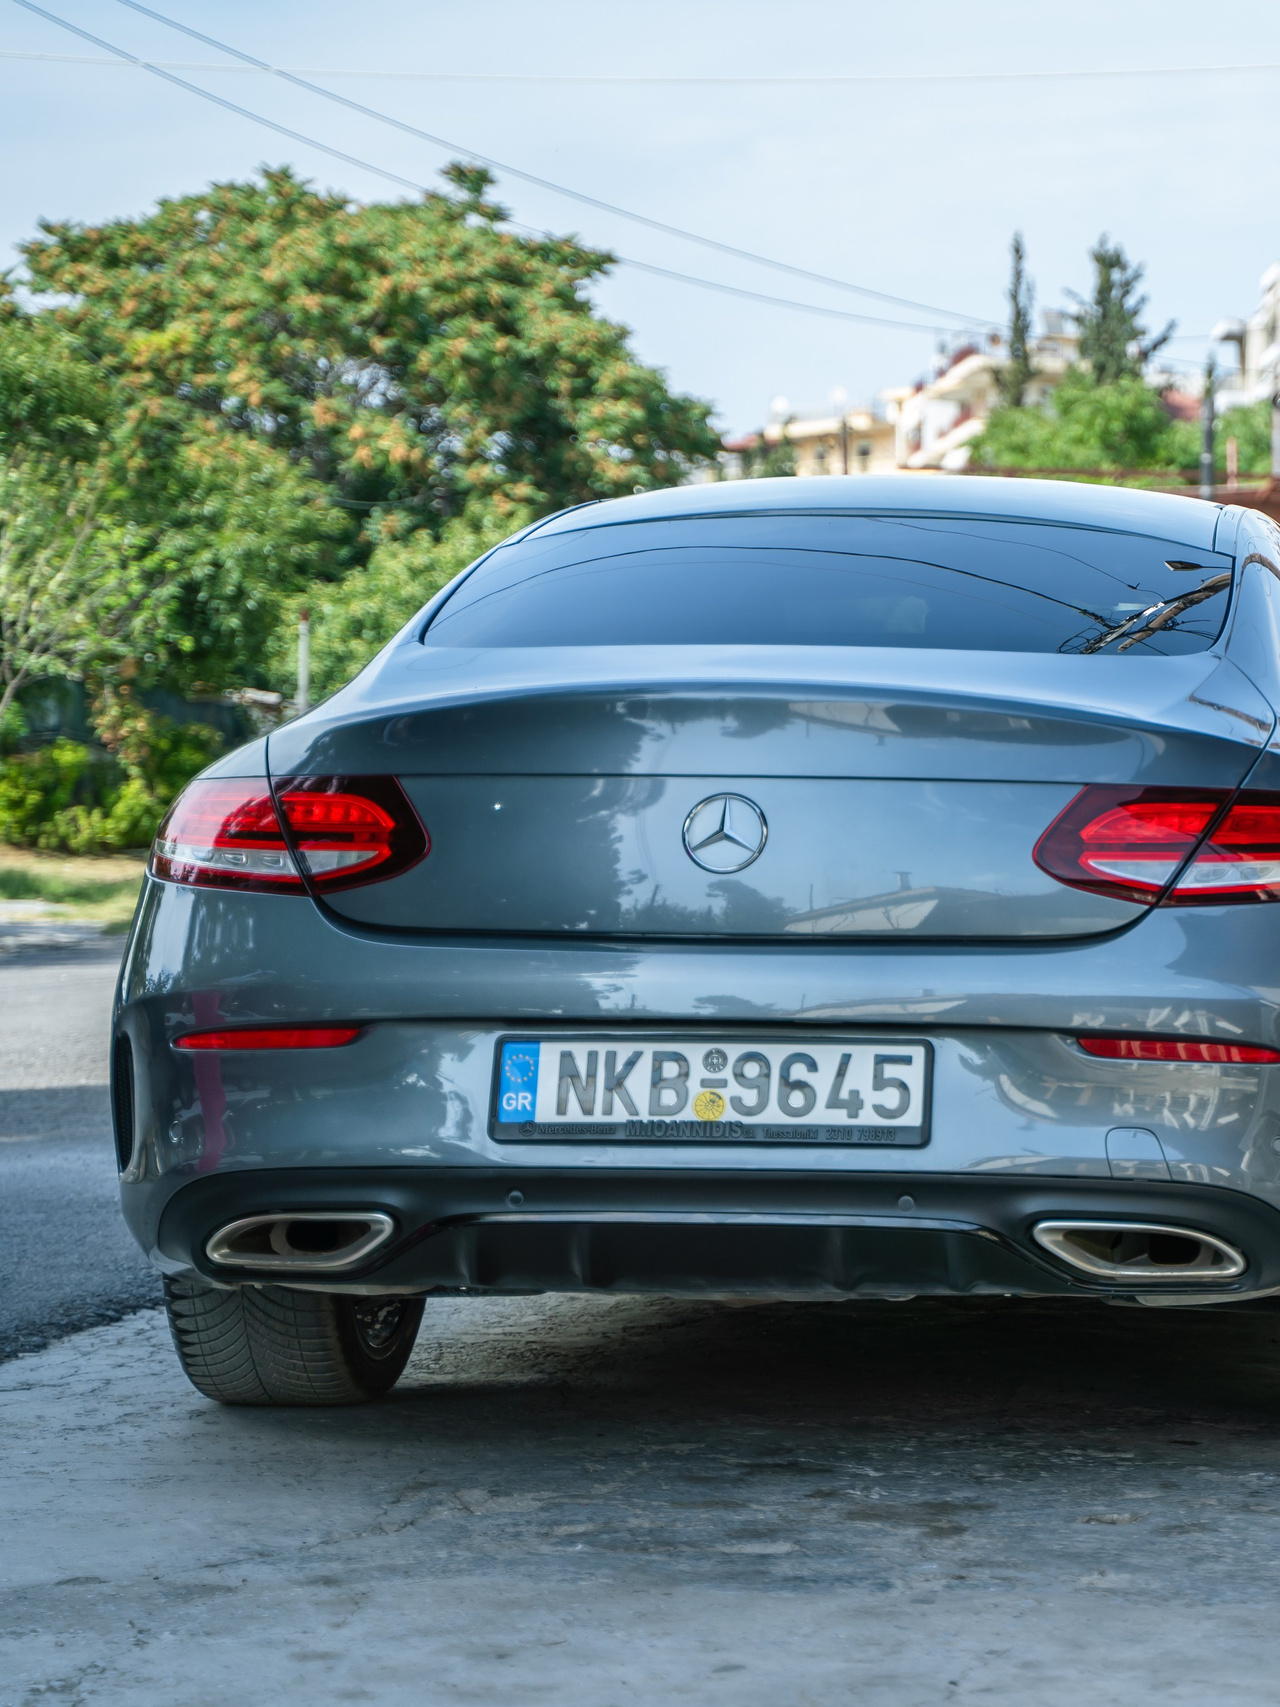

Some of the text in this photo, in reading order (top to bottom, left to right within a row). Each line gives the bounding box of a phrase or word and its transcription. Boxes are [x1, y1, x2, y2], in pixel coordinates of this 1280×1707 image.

[502, 1092, 532, 1111] GR
[537, 1123, 616, 1135] Mercedes-Benz
[762, 1128, 819, 1139] Thessaloniki
[825, 1127, 852, 1140] 2310
[856, 1128, 896, 1141] 798913
